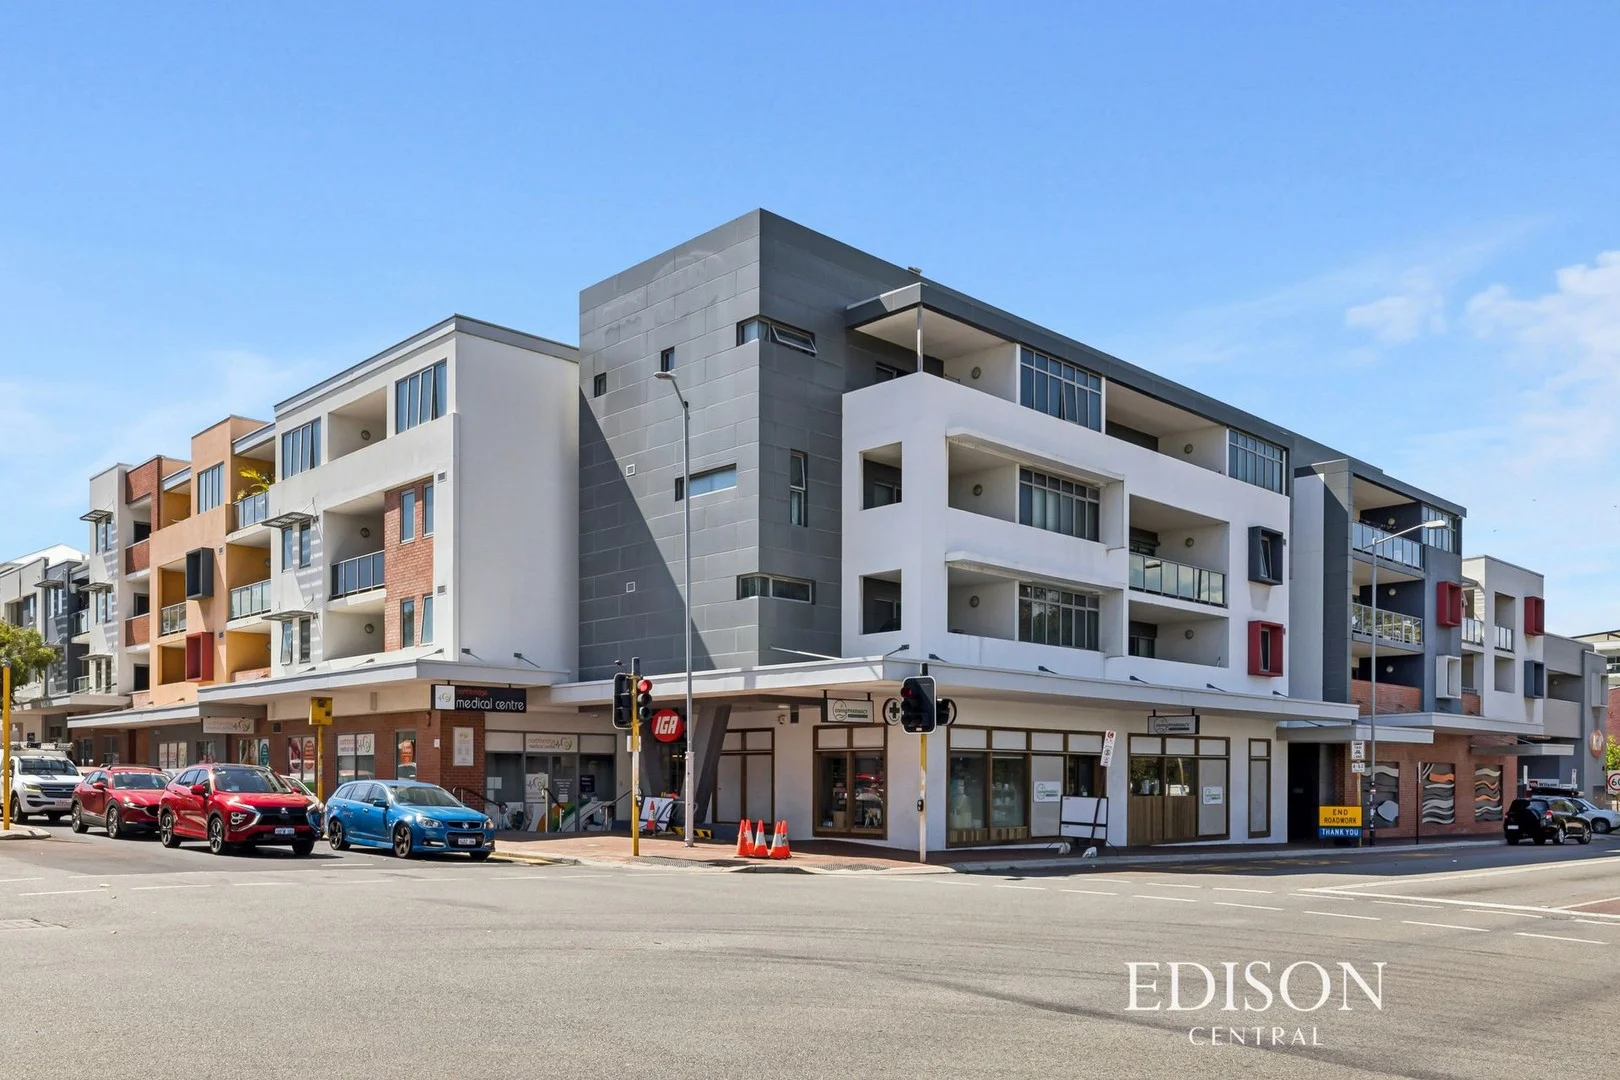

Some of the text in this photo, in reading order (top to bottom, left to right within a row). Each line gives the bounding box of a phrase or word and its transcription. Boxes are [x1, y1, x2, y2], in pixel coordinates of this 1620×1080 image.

[456, 697, 524, 711] medical centre
[654, 715, 679, 735] IGA
[1322, 828, 1359, 836] THANK YOU
